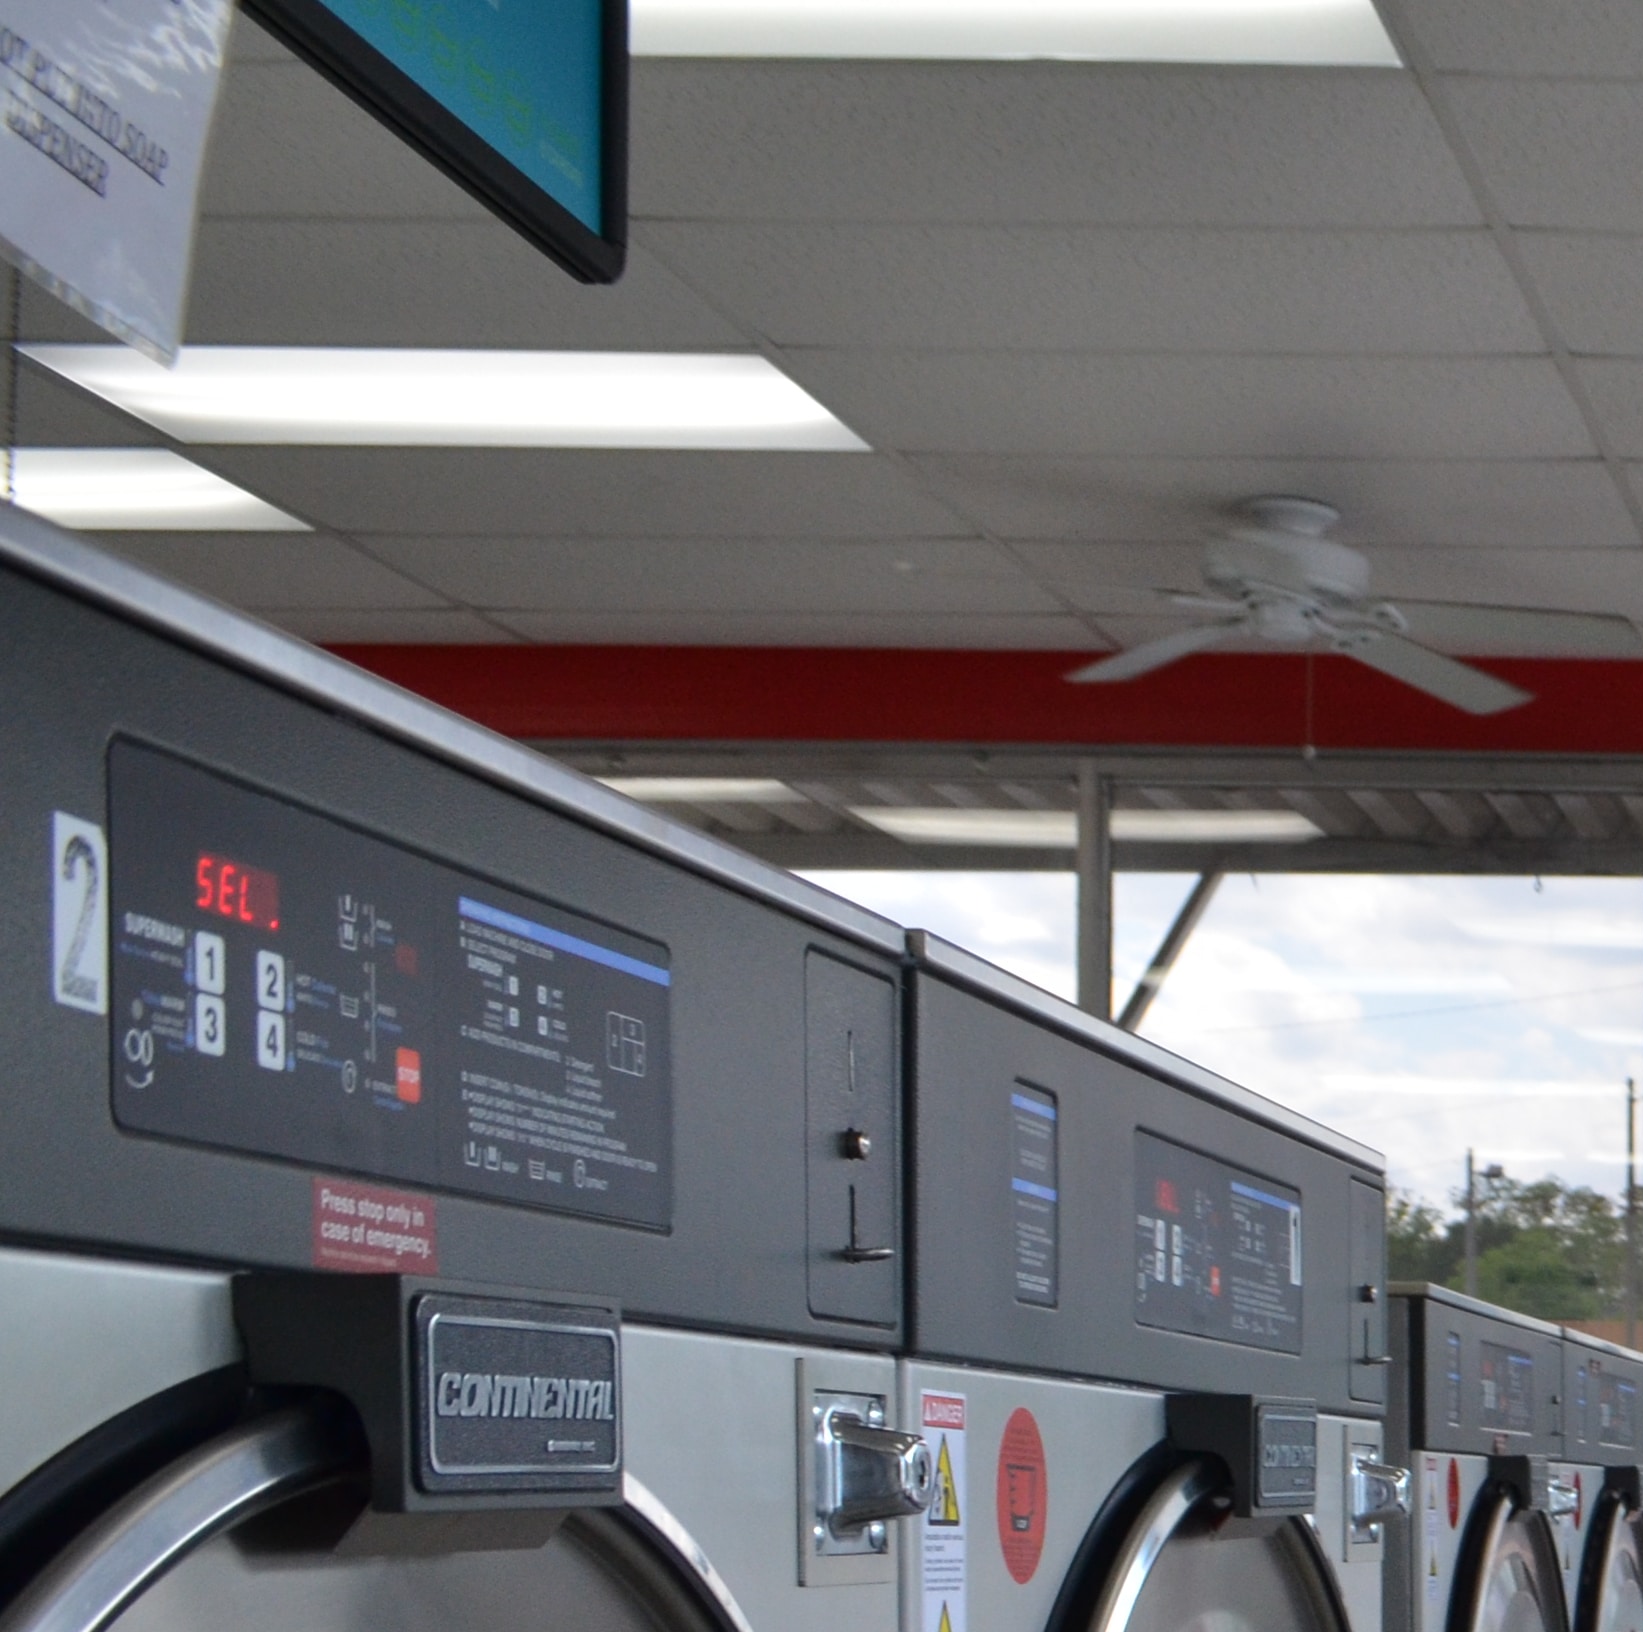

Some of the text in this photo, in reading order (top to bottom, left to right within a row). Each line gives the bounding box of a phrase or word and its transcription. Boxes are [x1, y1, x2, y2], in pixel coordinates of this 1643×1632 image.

[124, 122, 169, 185] SOAP
[62, 833, 99, 1003] 2
[205, 946, 215, 981] 1
[266, 963, 278, 999] 2
[205, 1008, 217, 1044] 3
[266, 1023, 278, 1059] 4
[397, 1065, 421, 1084] STOP
[321, 1188, 424, 1230] Press stop only in
[321, 1221, 350, 1243] case
[352, 1223, 365, 1243] of
[366, 1229, 432, 1259] emergency.
[436, 1371, 615, 1421] CONTINENTAL
[931, 1400, 964, 1425] DANGER
